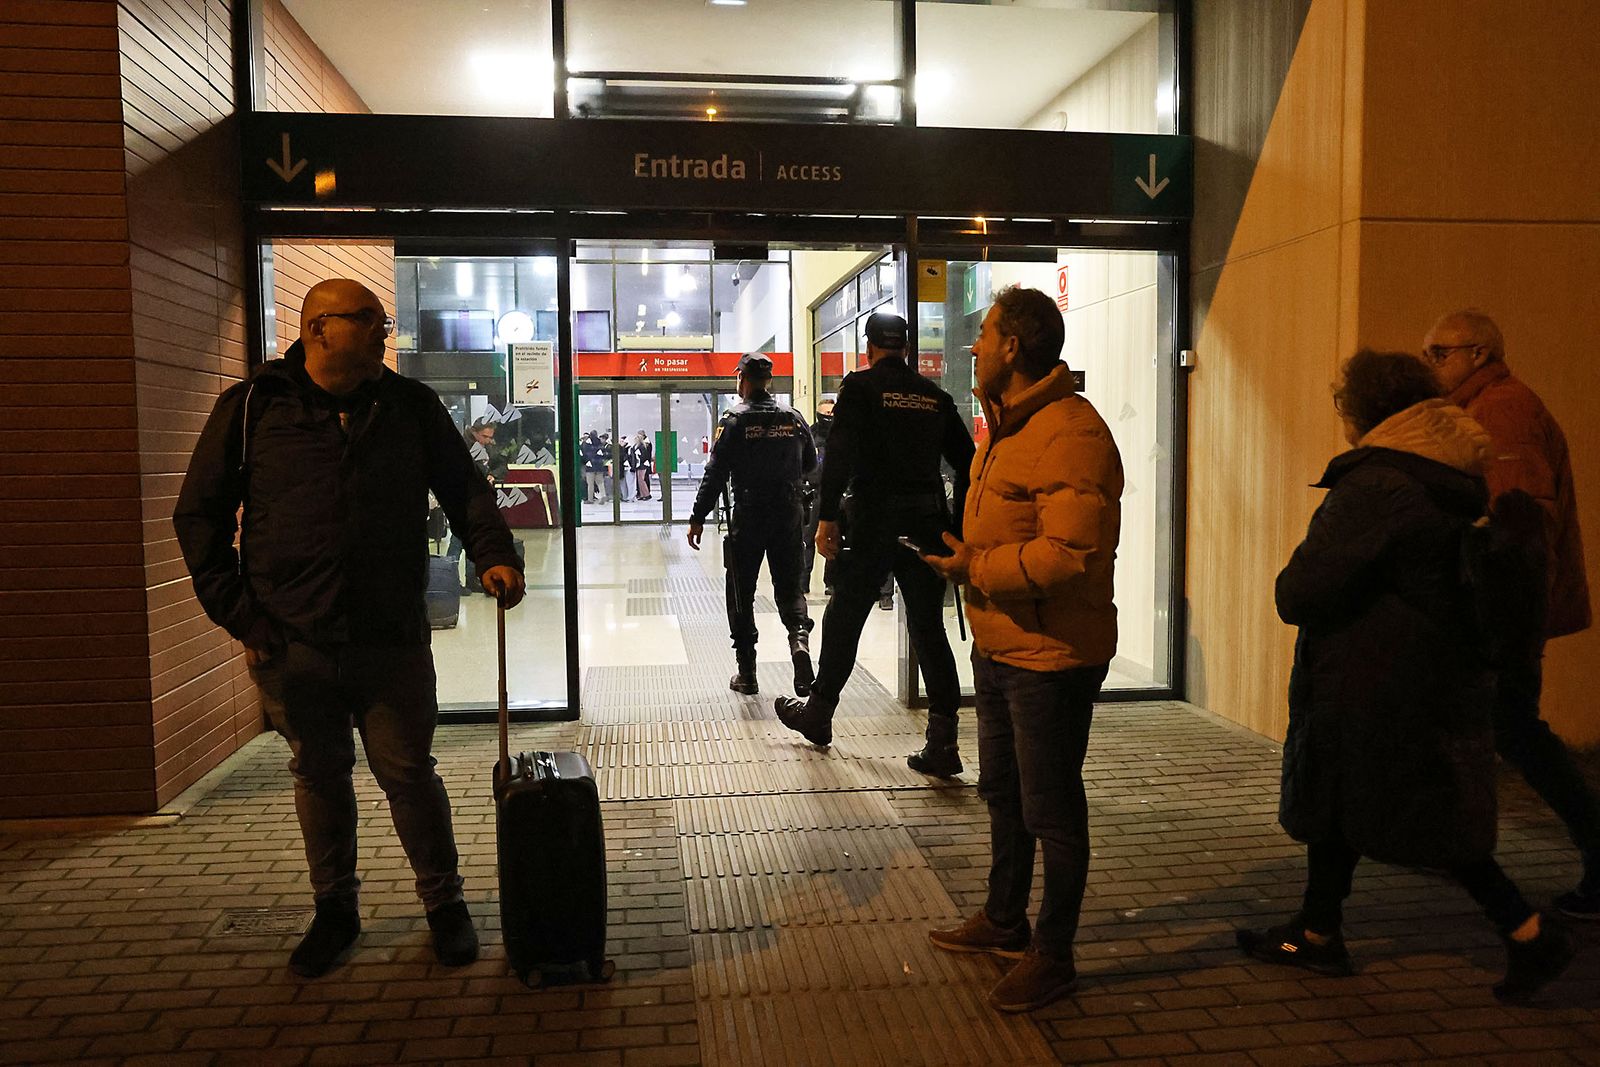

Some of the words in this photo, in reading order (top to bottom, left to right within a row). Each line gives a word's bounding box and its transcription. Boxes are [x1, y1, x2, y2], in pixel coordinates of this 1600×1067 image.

[634, 153, 746, 179] Entrada
[776, 165, 842, 181] ACCESS
[667, 359, 688, 367] pasar
[883, 400, 939, 412] NACIONAL
